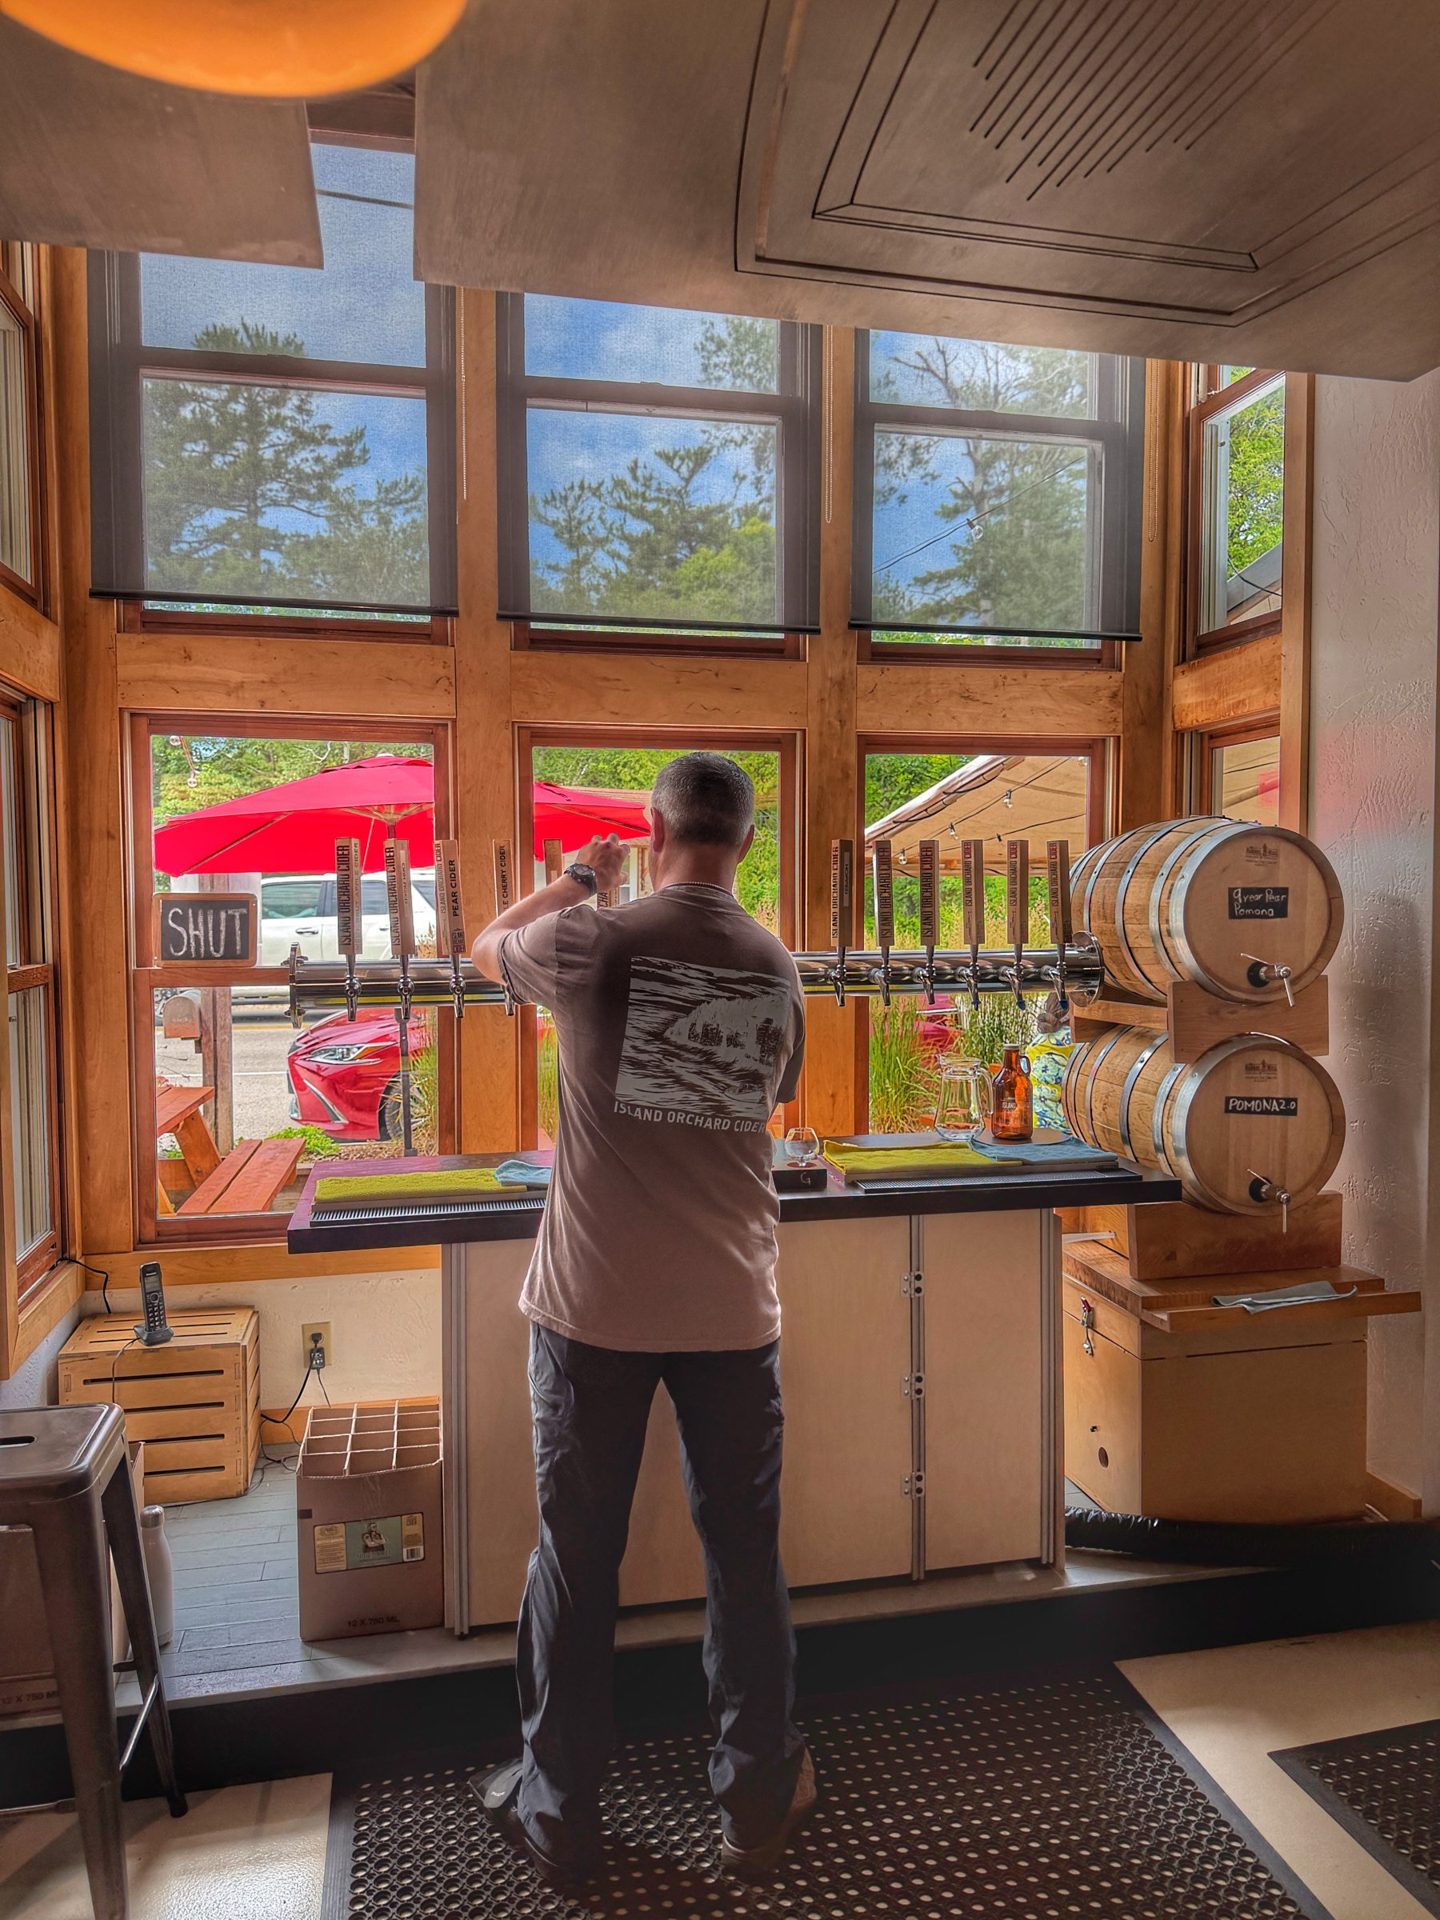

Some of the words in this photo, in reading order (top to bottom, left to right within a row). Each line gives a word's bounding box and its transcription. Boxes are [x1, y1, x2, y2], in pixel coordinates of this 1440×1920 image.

[336, 845, 350, 872] CIDER
[385, 846, 396, 873] CIDER
[435, 843, 443, 862] CIDER
[499, 845, 507, 868] CIDER
[831, 846, 839, 871] CIDER
[878, 847, 891, 872] CIDER
[921, 846, 934, 871] CIDER
[963, 841, 972, 859] CIDER
[1009, 841, 1018, 859] CIDER
[1049, 842, 1058, 860] CIDER
[448, 859, 457, 889] CIDER
[501, 869, 509, 899] CHERRY
[337, 874, 351, 913] ORCHARD
[387, 874, 399, 914] ORCHARD
[450, 890, 460, 917] PEAR
[831, 872, 839, 909] ORCHARD
[879, 873, 892, 909] ORCHARD
[921, 872, 934, 909] ORCHARD
[964, 887, 973, 907] ISLAND
[1009, 887, 1018, 907] ISLAND
[1050, 887, 1059, 907] ISLAND
[1233, 901, 1275, 917] Pomona
[168, 907, 247, 959] SHUT
[339, 916, 352, 946] ISLAND
[391, 916, 401, 946] ISLAND
[831, 911, 839, 939] ISLAND
[880, 911, 894, 939] ISLAND
[922, 911, 934, 938] ISLAND
[613, 1101, 663, 1123] ISLAND
[667, 1111, 731, 1132] ORCHARD
[734, 1119, 766, 1134] CIDER
[1228, 1098, 1280, 1112] POMONA
[1279, 1099, 1297, 1110] 2.0
